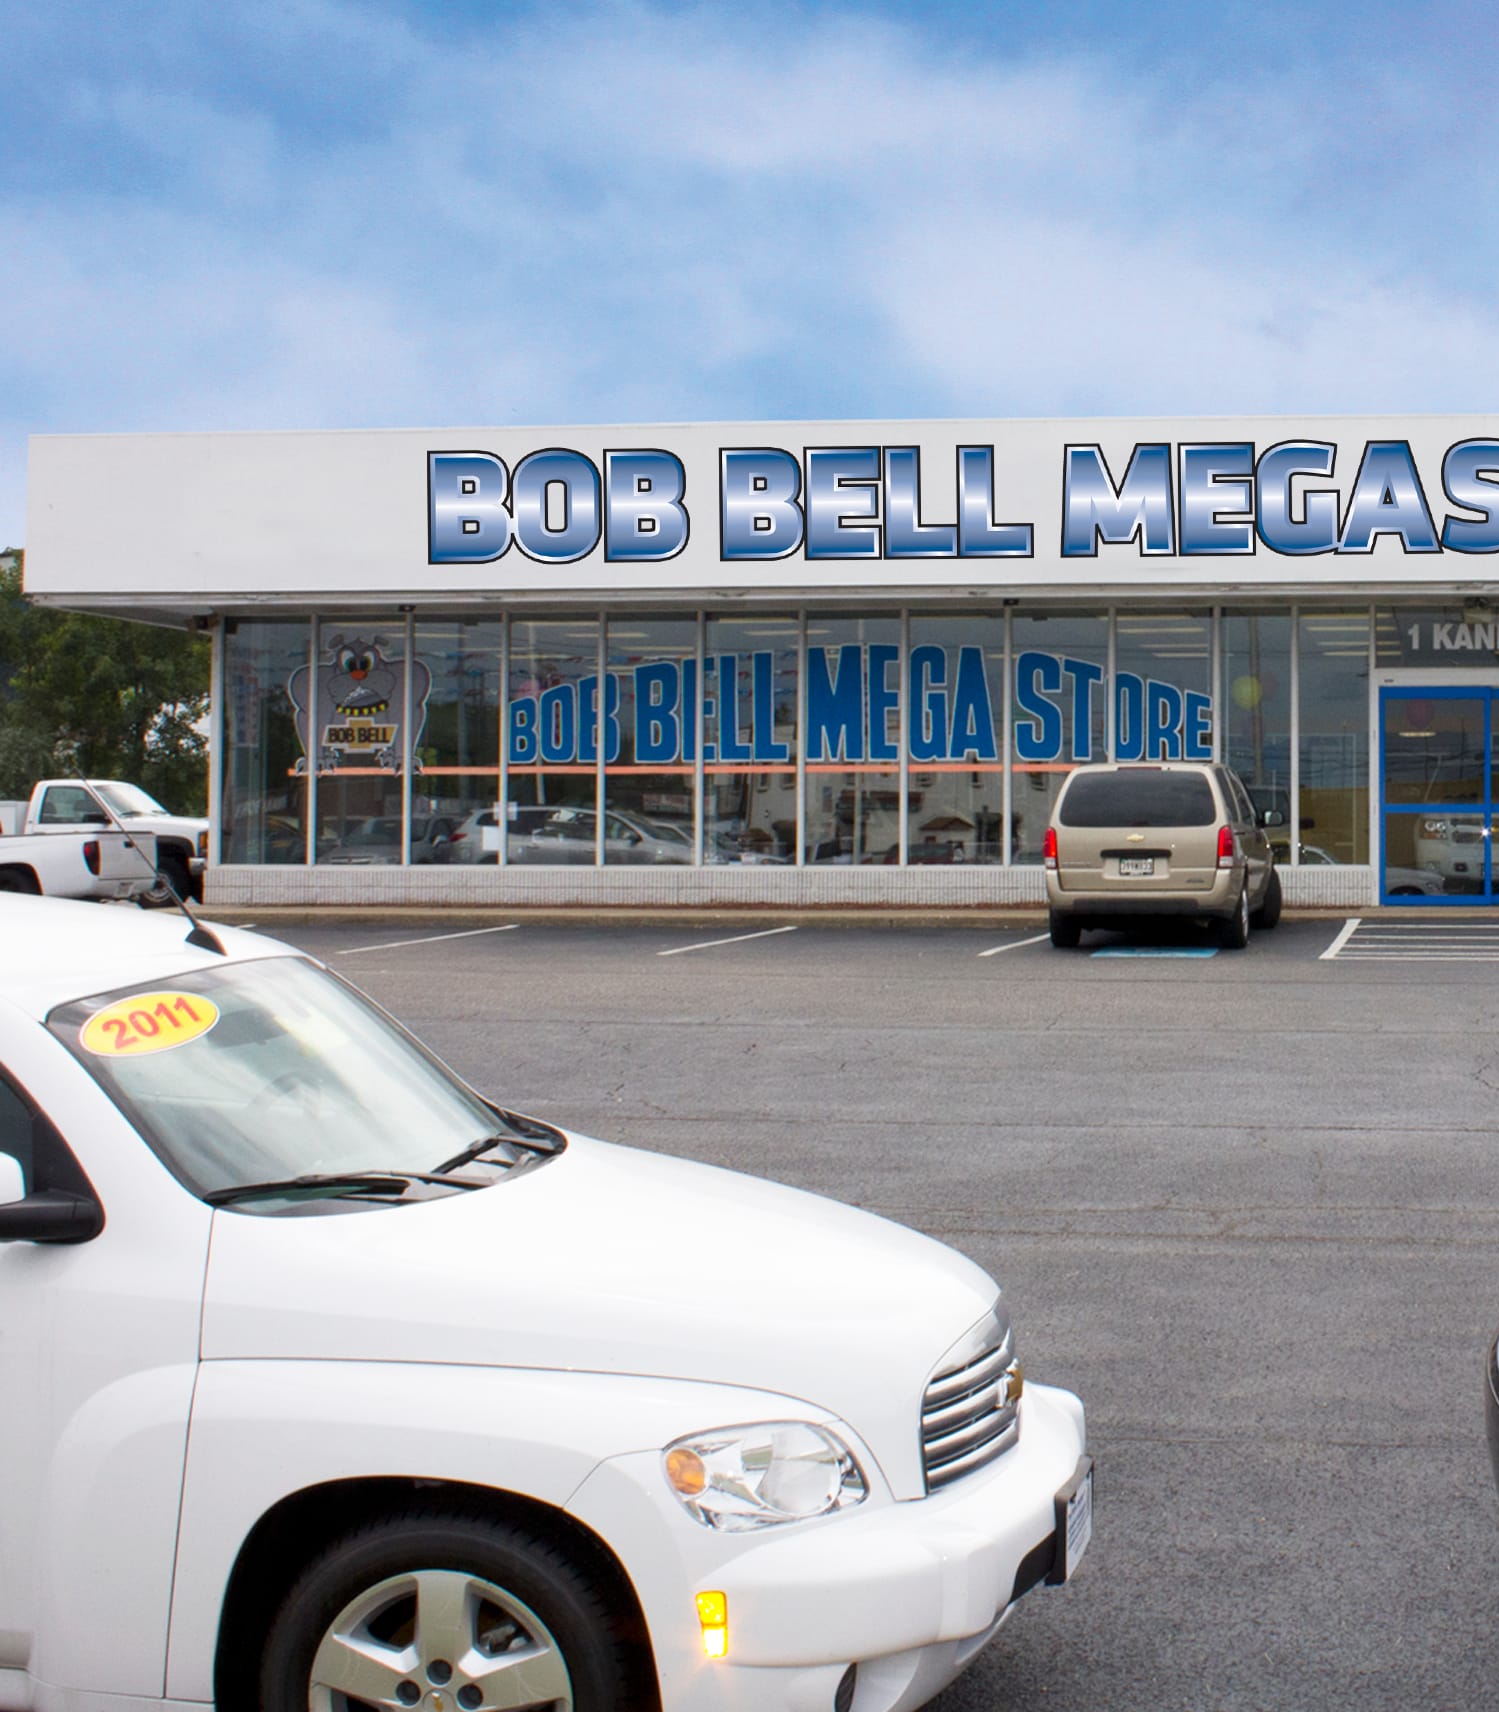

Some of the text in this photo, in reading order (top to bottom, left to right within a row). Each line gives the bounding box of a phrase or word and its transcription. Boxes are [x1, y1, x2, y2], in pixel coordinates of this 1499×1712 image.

[427, 448, 690, 565] BOB
[719, 445, 1034, 561] BELL
[1408, 623, 1420, 650] 1
[508, 643, 1213, 763] BOB BELL MEGA STORE
[327, 727, 390, 743] BOB BELL
[102, 997, 200, 1049] 2011
